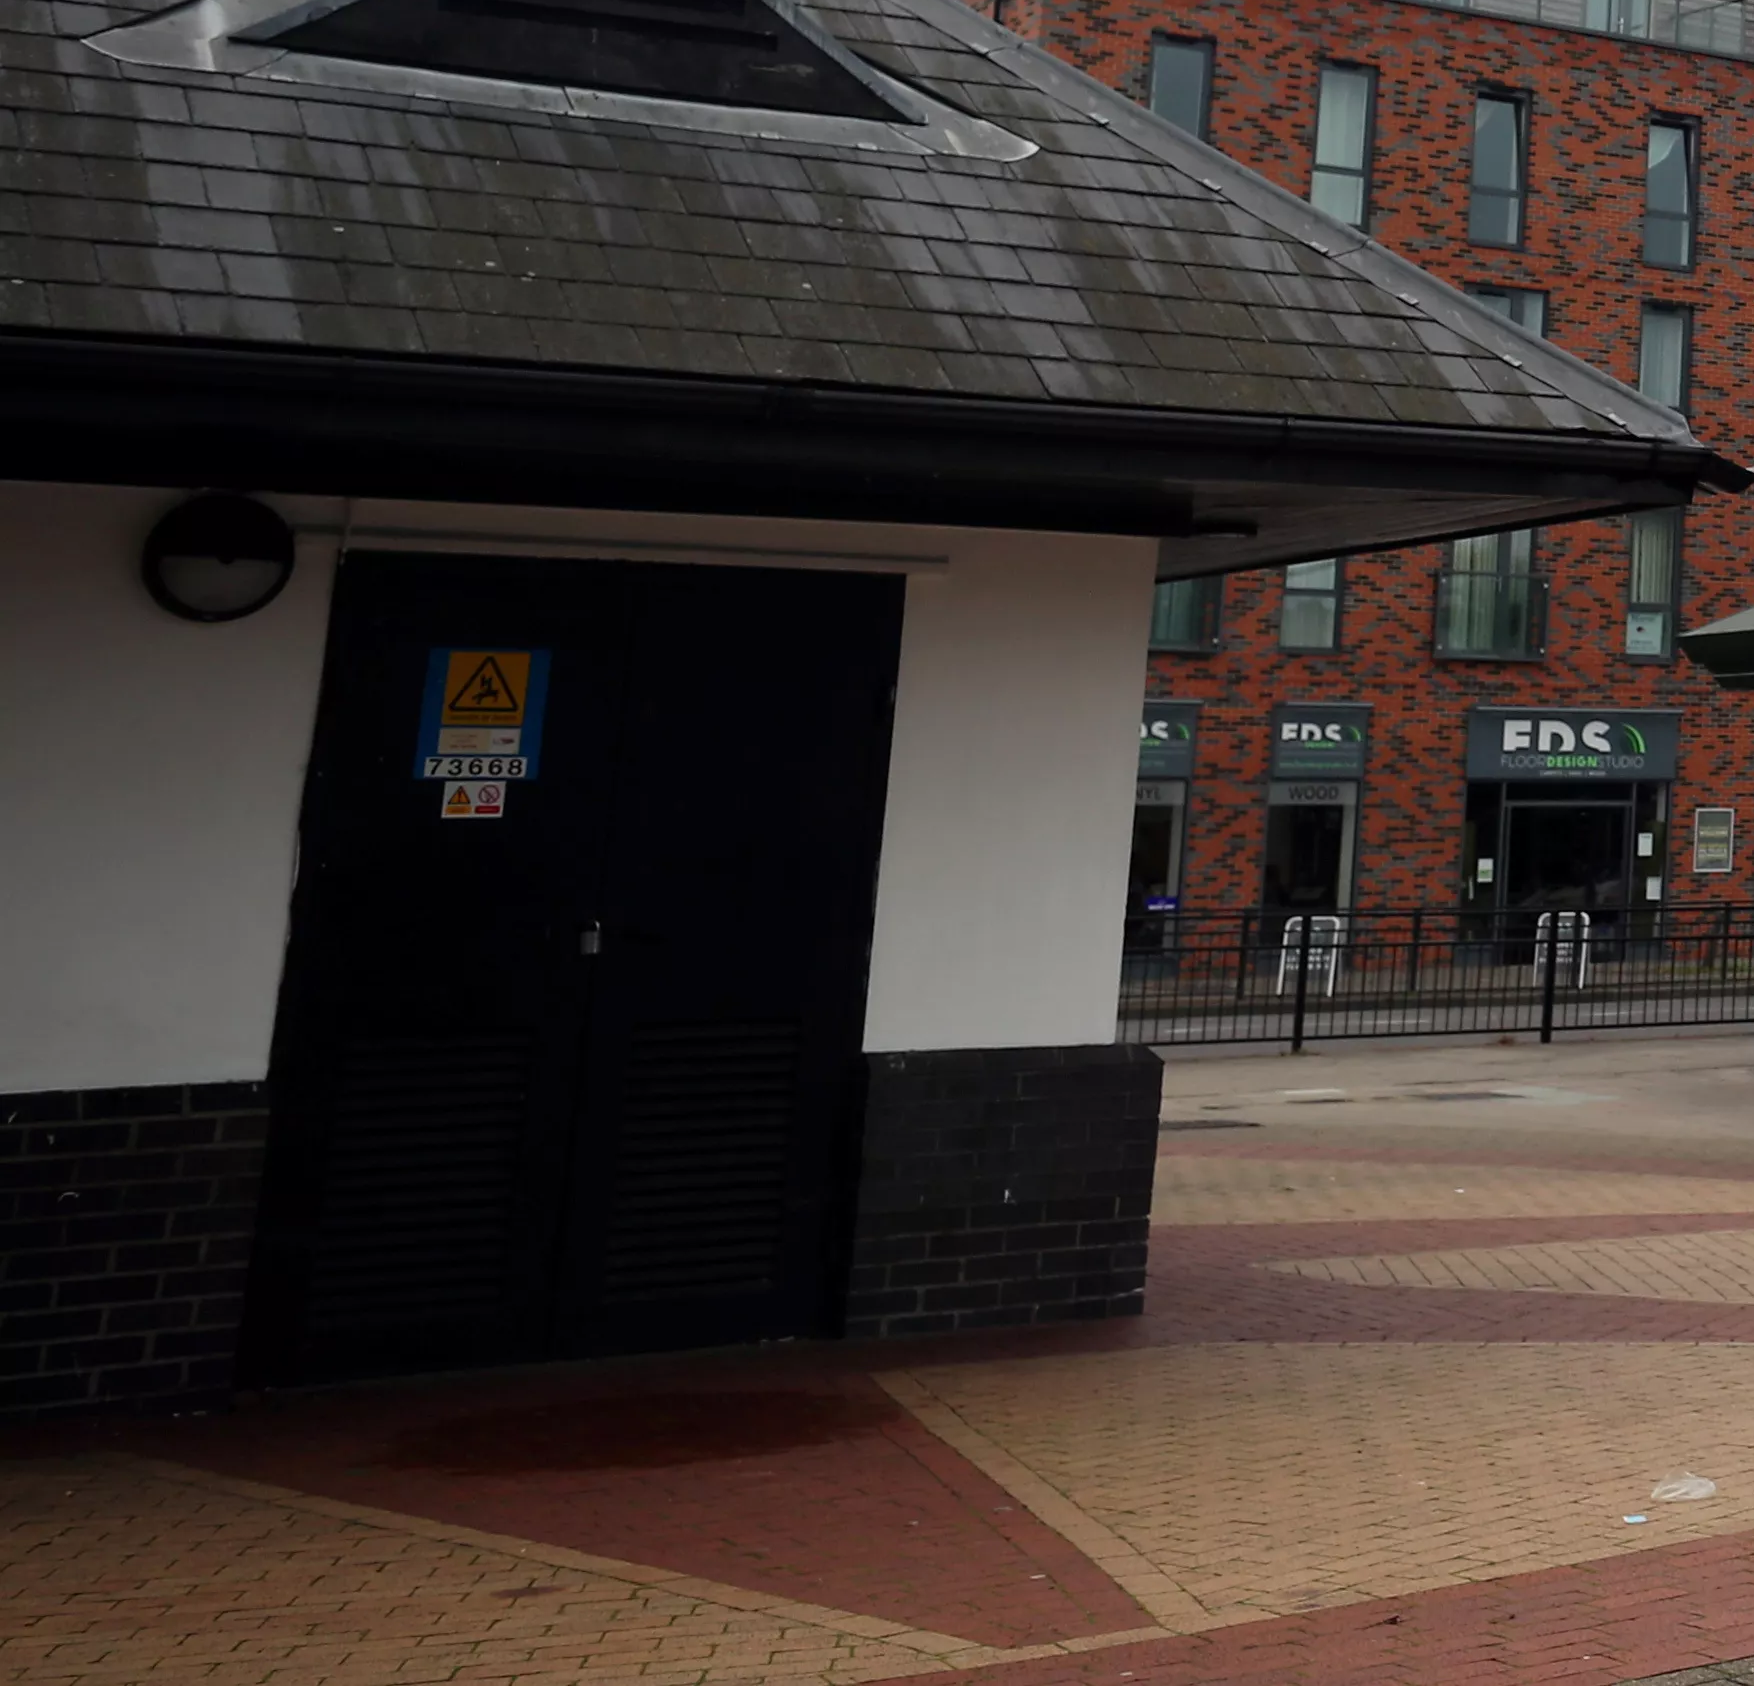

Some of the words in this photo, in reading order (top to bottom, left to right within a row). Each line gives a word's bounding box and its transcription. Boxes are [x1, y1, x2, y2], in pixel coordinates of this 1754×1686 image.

[1281, 722, 1342, 742] FDS
[1503, 720, 1611, 752] FDS
[429, 759, 523, 777] 73668
[1288, 786, 1339, 801] WOOD
